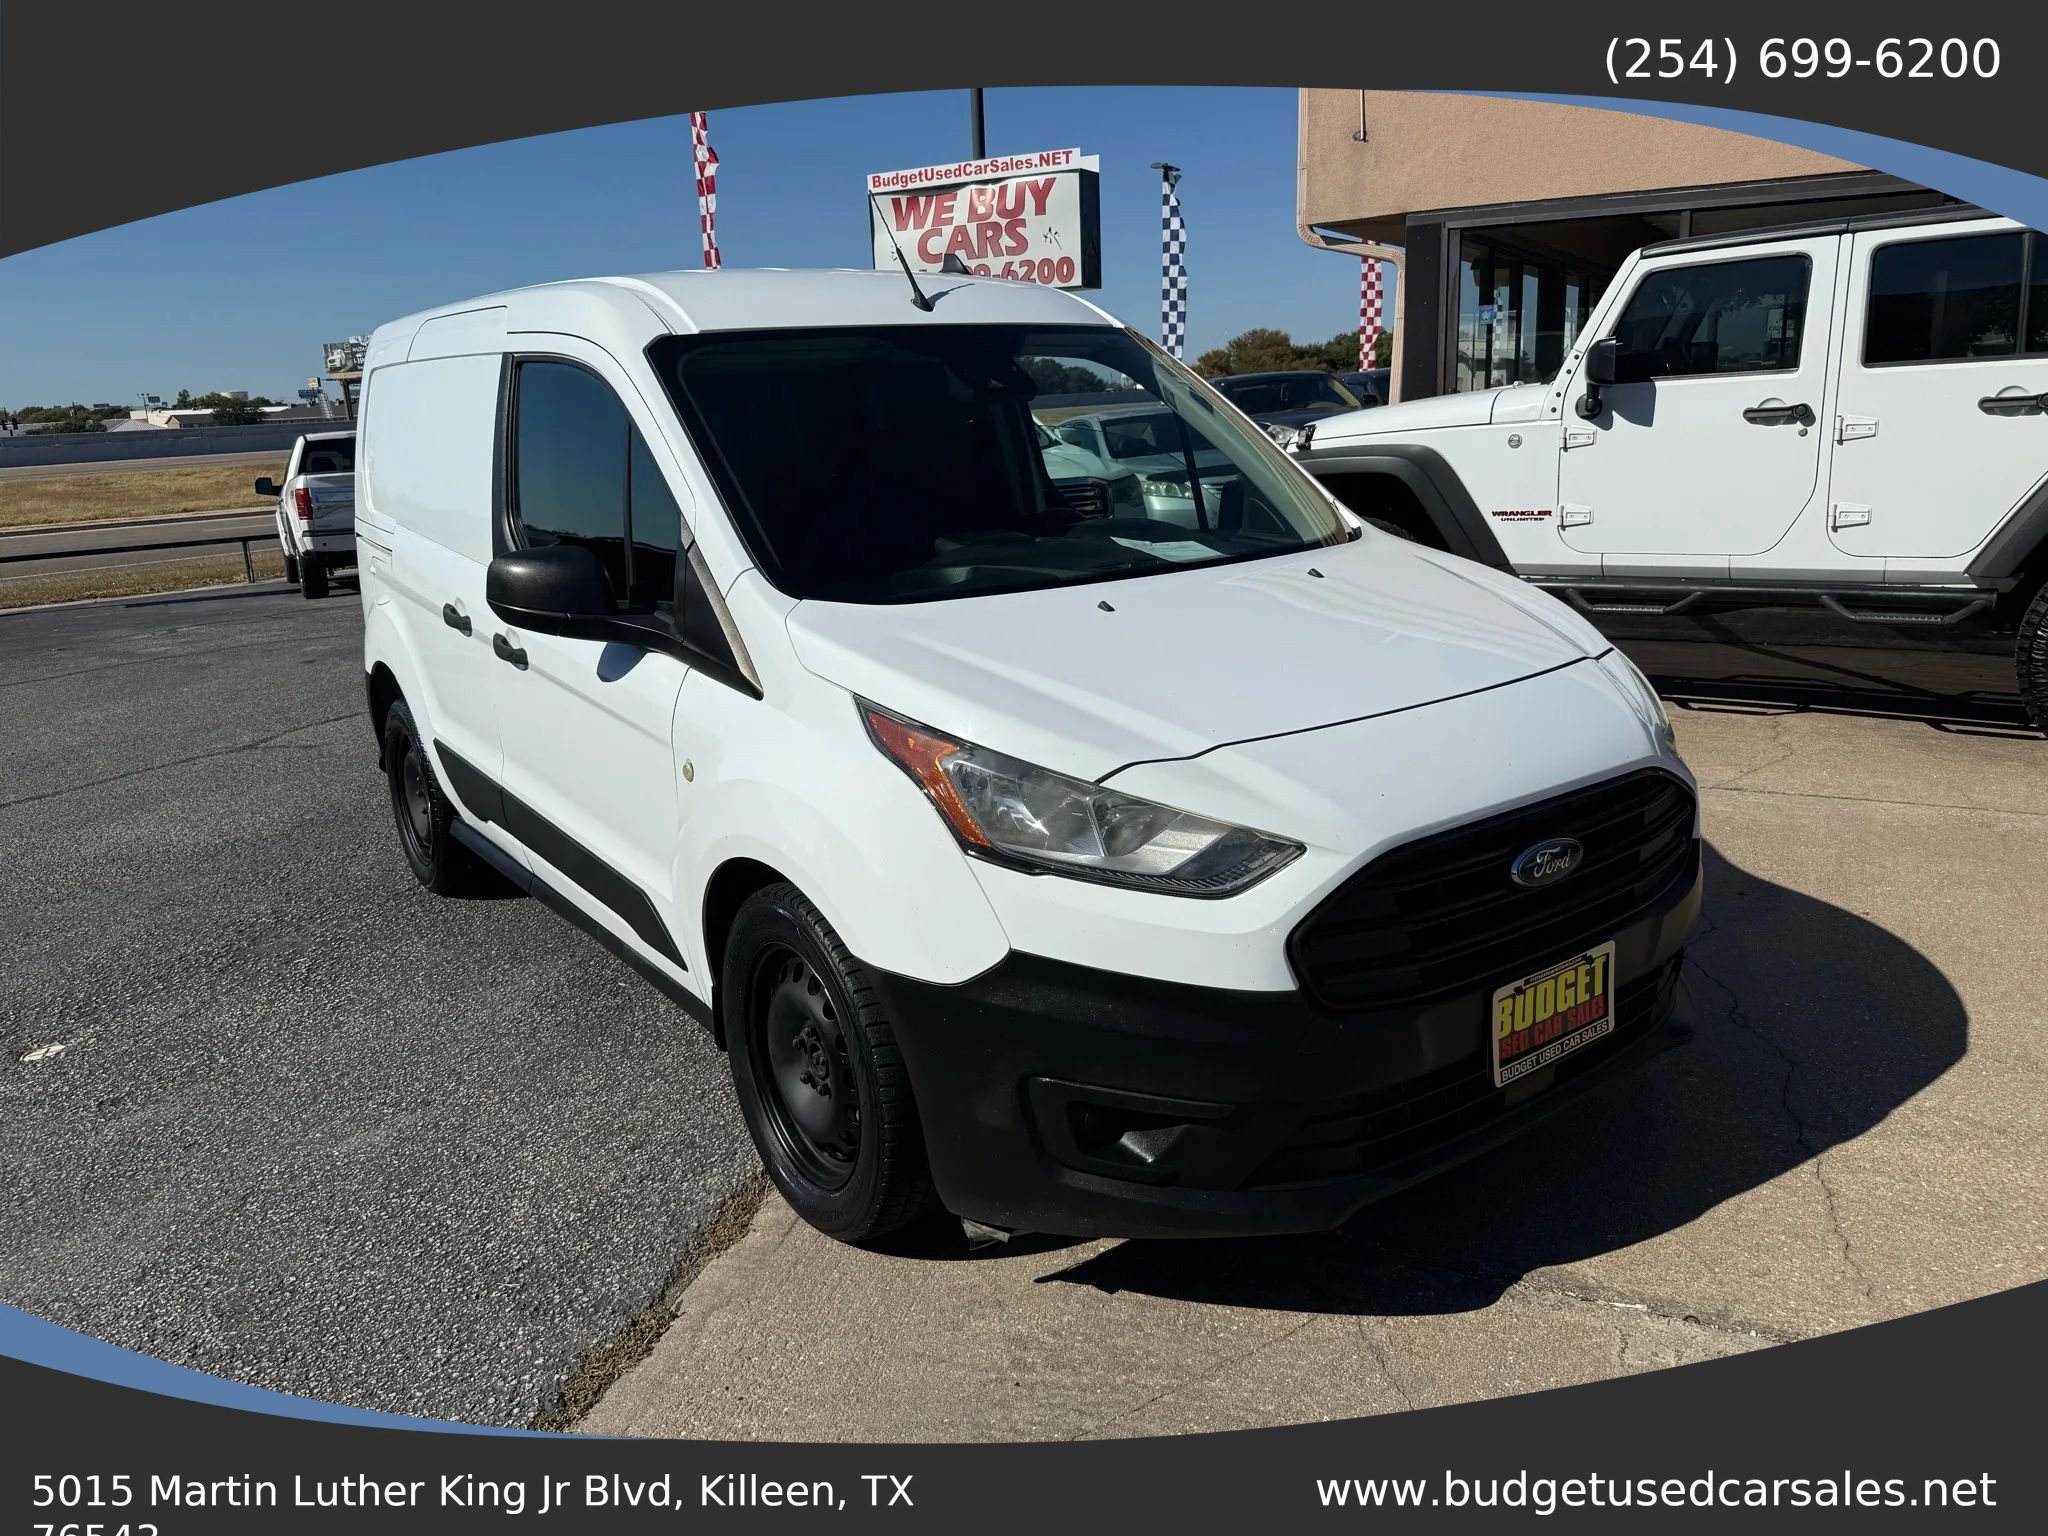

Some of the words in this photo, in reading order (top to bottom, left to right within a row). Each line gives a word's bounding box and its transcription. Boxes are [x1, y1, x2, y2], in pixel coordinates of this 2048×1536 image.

[872, 150, 1073, 188] BudgetUsedCarSales.NET
[891, 192, 958, 232] WE
[967, 177, 1057, 223] BUY
[917, 218, 1029, 264] CARS
[1534, 846, 1570, 878] Ford
[1497, 955, 1607, 1040] BUDGET
[1501, 1055, 1538, 1082] BUDGET
[1539, 1044, 1561, 1064] USED
[1563, 1034, 1581, 1051] CAR
[1582, 1021, 1608, 1042] SALES
